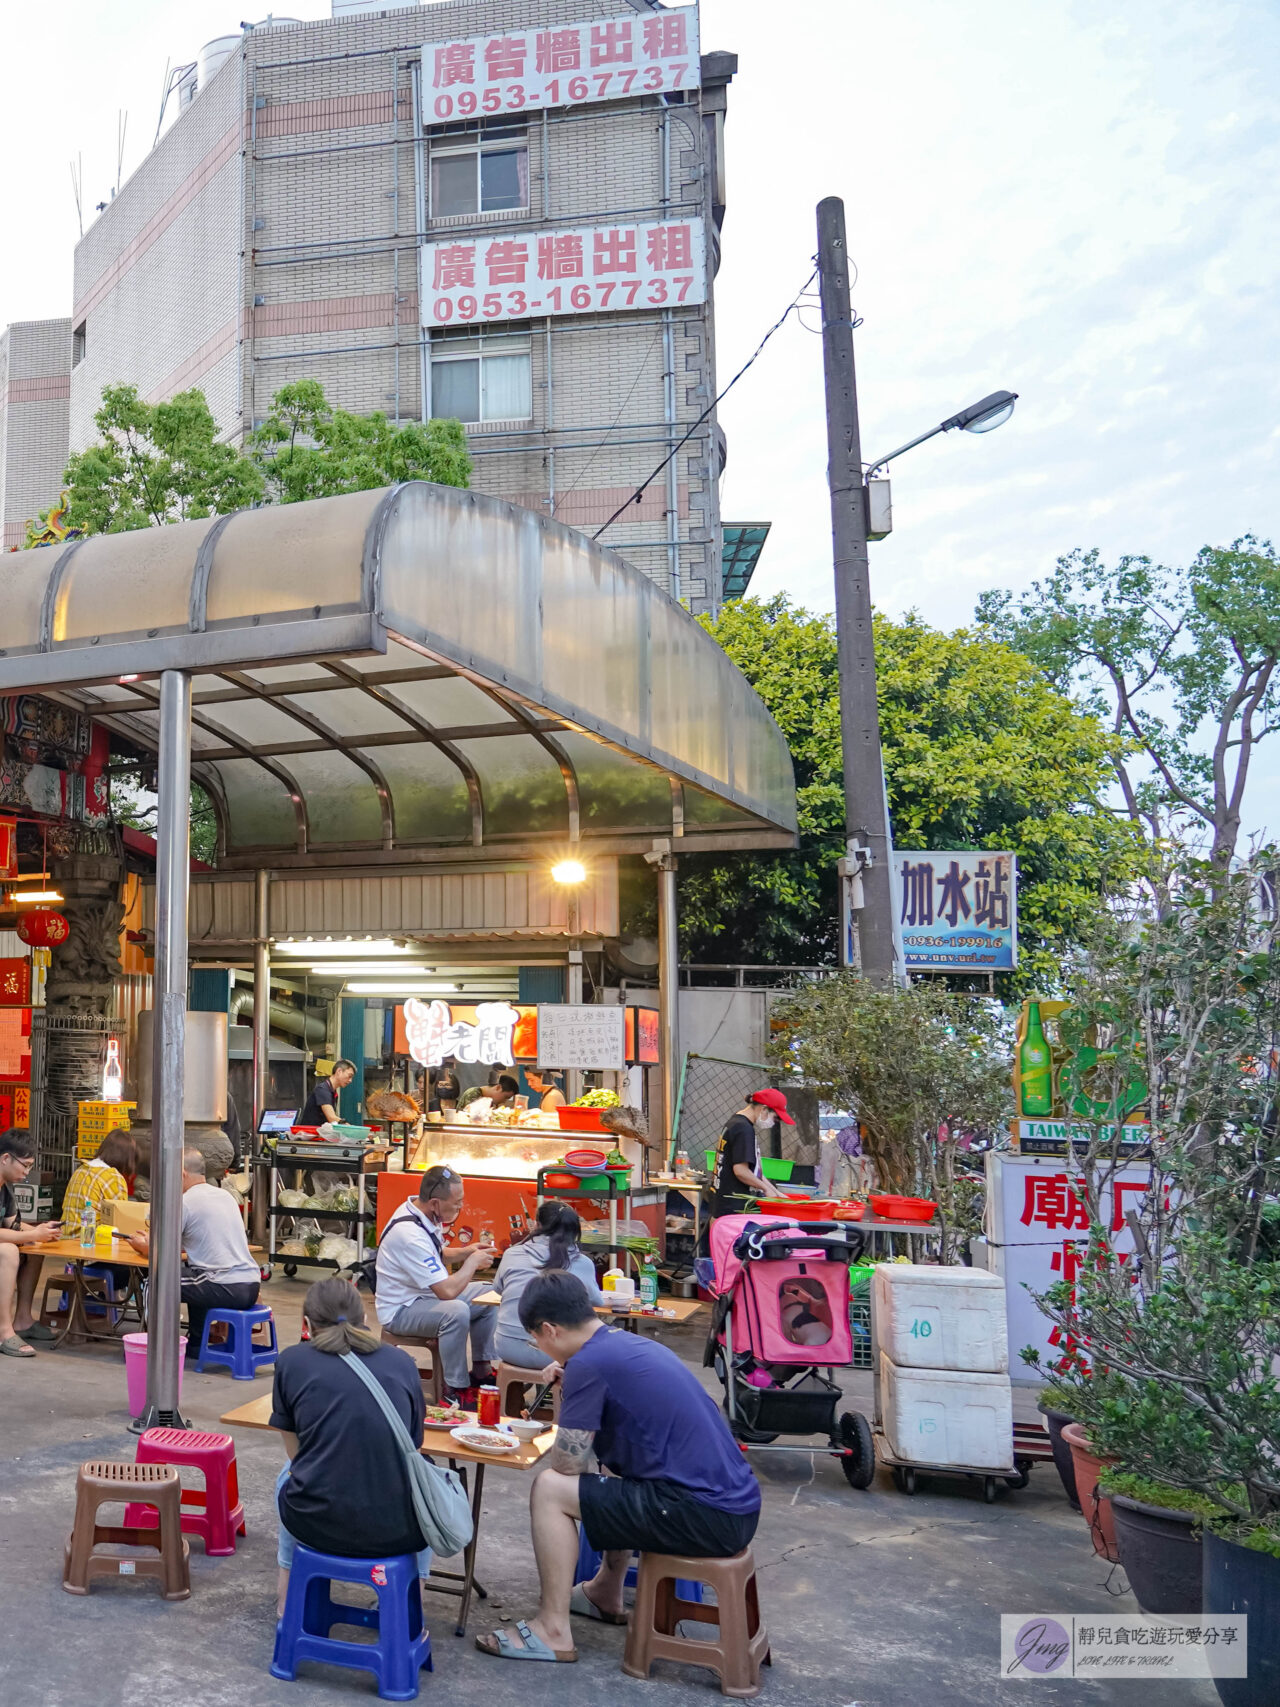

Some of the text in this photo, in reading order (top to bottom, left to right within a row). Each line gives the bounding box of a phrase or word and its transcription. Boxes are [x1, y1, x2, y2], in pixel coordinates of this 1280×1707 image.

[432, 13, 689, 89] 廣告牆出租
[433, 63, 690, 119] 0953-167737
[432, 224, 693, 291] 廣告牆出租
[433, 276, 694, 322] 0953-167737
[900, 860, 1009, 930] 加水站
[15, 1089, 28, 1122] 公休
[909, 1318, 933, 1339] 10
[919, 1418, 937, 1434] 15
